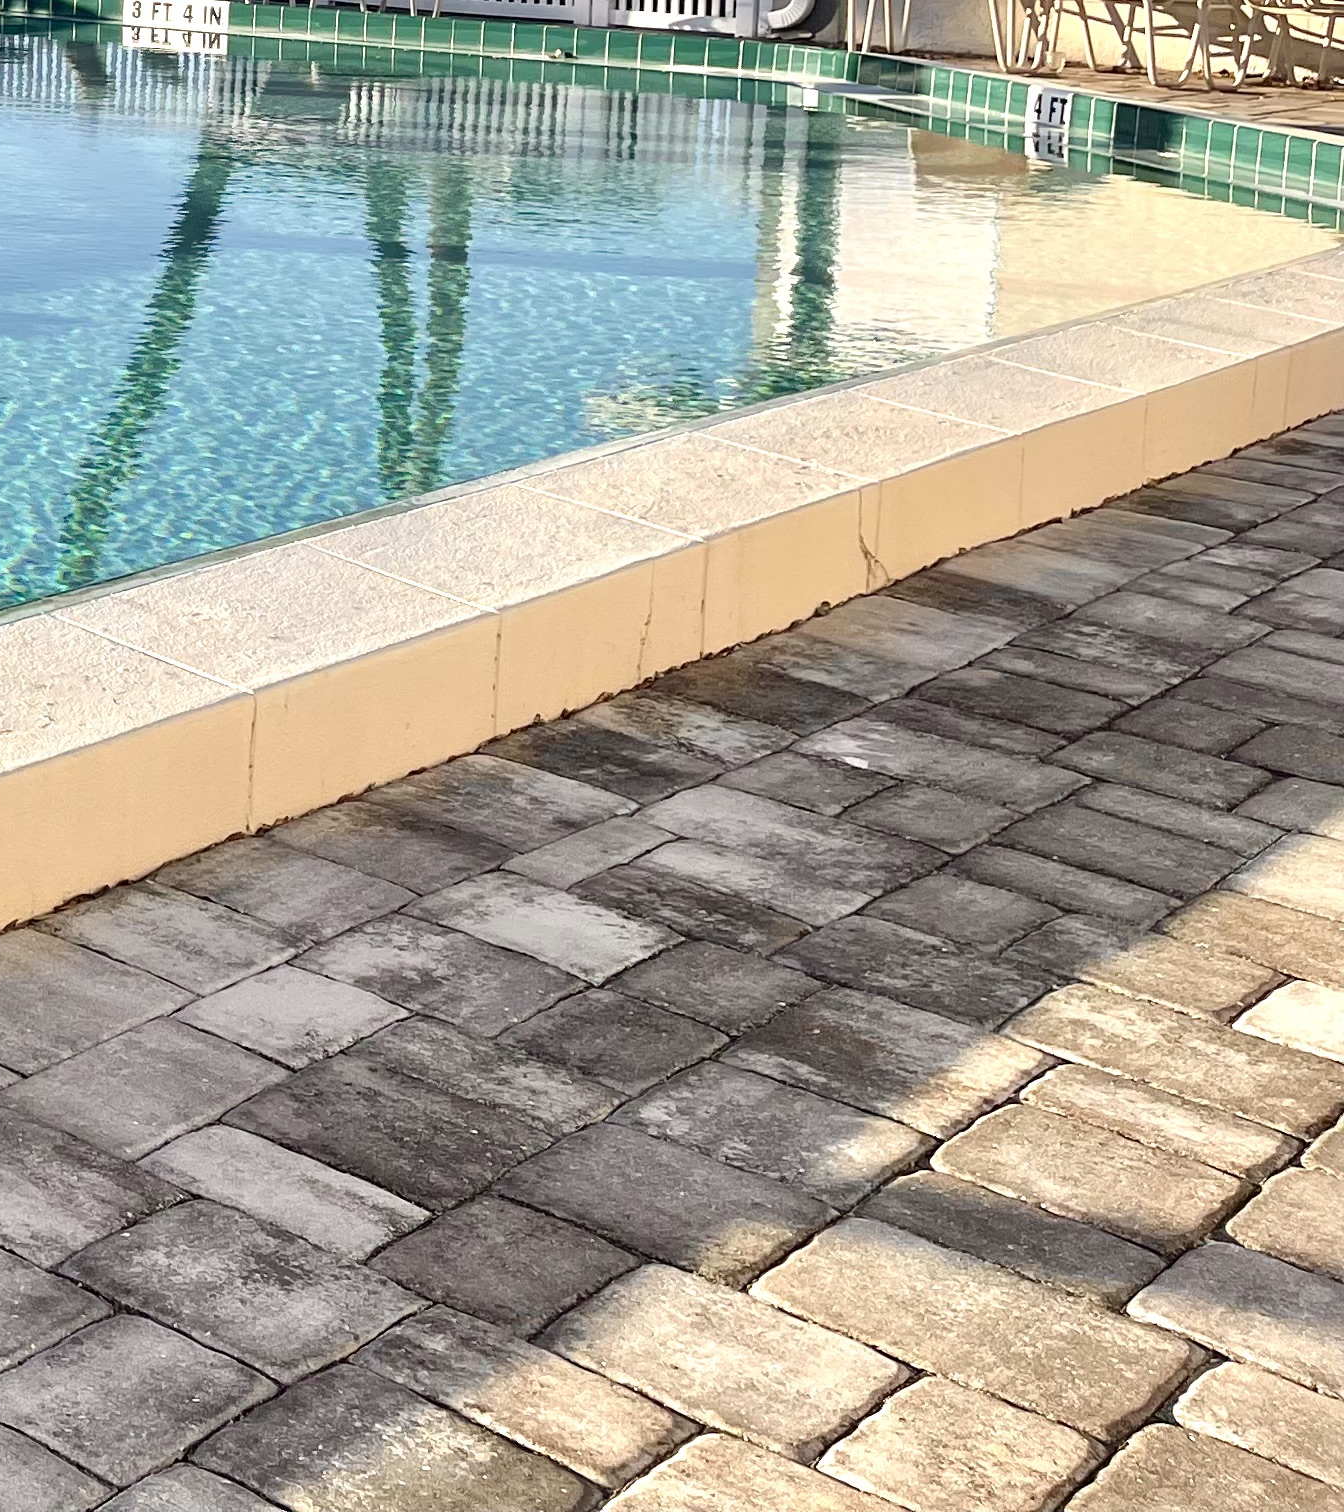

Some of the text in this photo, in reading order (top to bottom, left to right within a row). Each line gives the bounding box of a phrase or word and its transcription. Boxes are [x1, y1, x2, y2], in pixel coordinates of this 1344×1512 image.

[132, 0, 142, 18] 3
[182, 4, 193, 23] 4
[1034, 94, 1042, 120] 4
